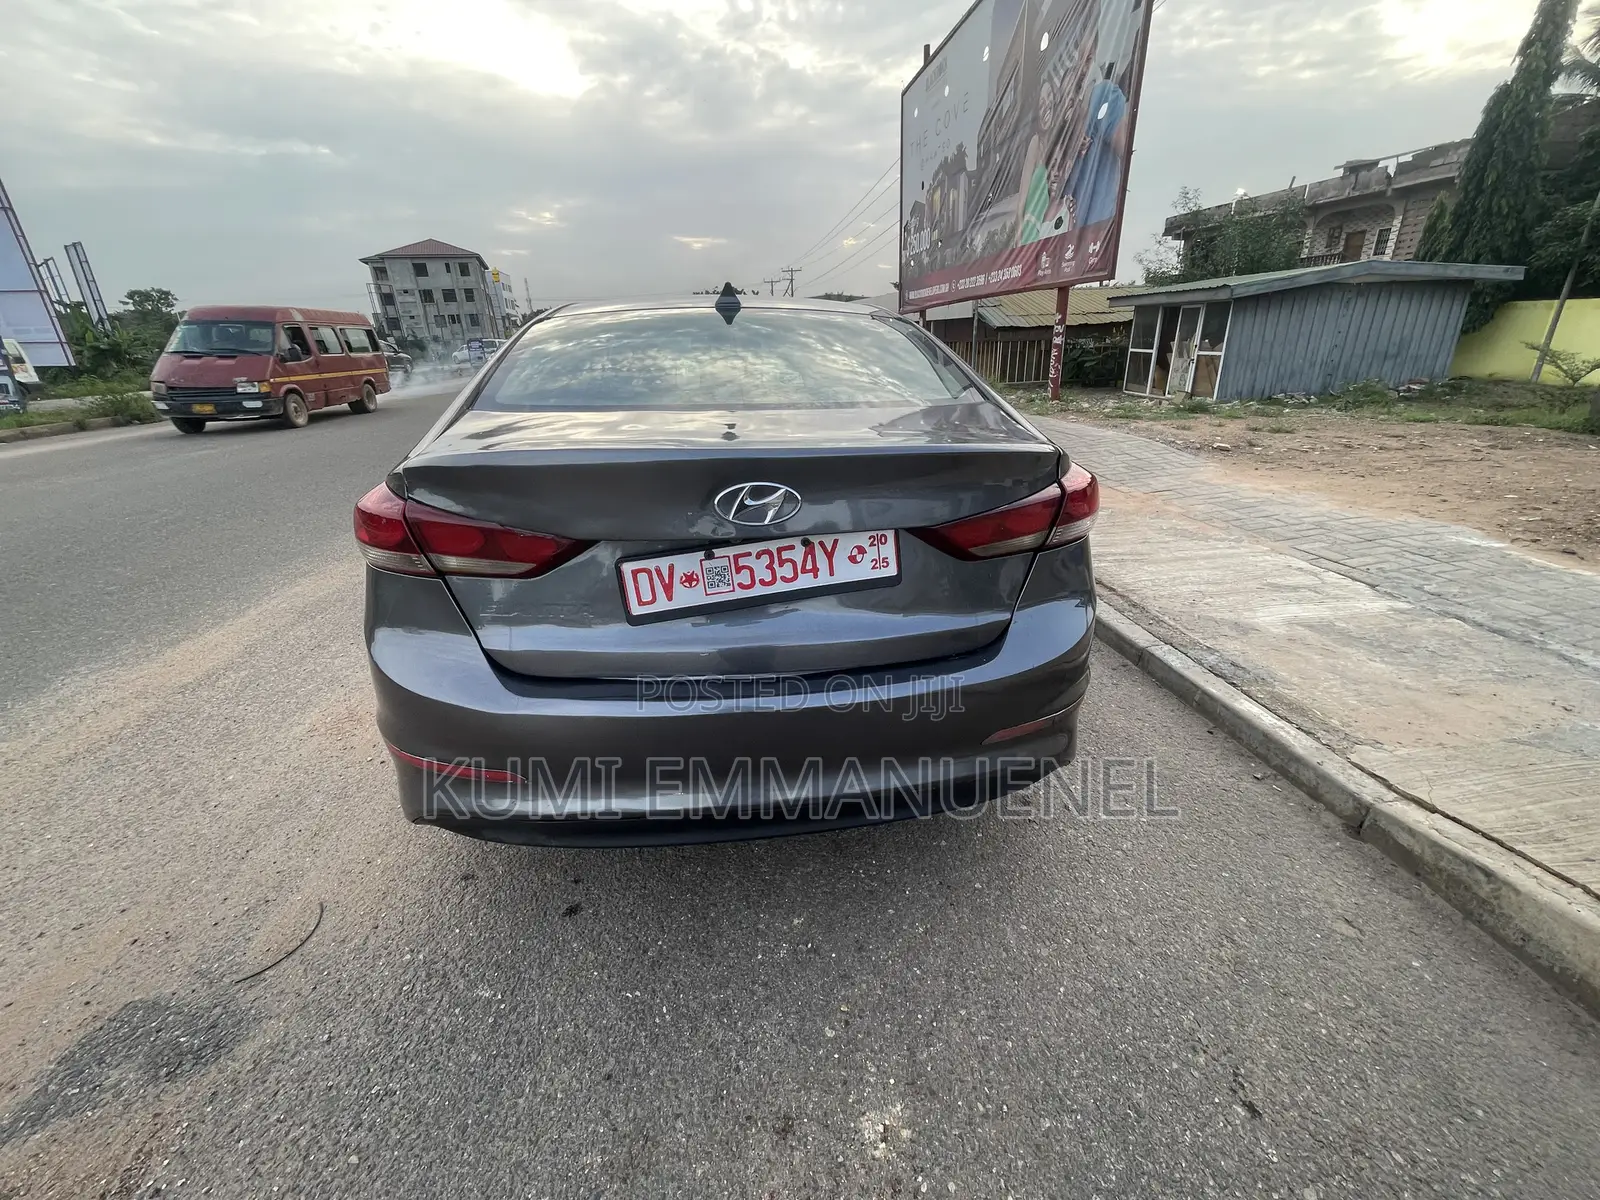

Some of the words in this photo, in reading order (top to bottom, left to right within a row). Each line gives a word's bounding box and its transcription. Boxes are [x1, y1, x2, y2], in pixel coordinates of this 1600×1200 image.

[909, 129, 928, 157] THE
[935, 91, 969, 137] COVE
[868, 532, 888, 547] 20
[630, 562, 675, 607] DV
[733, 538, 840, 591] 5354Y
[870, 557, 890, 570] 25
